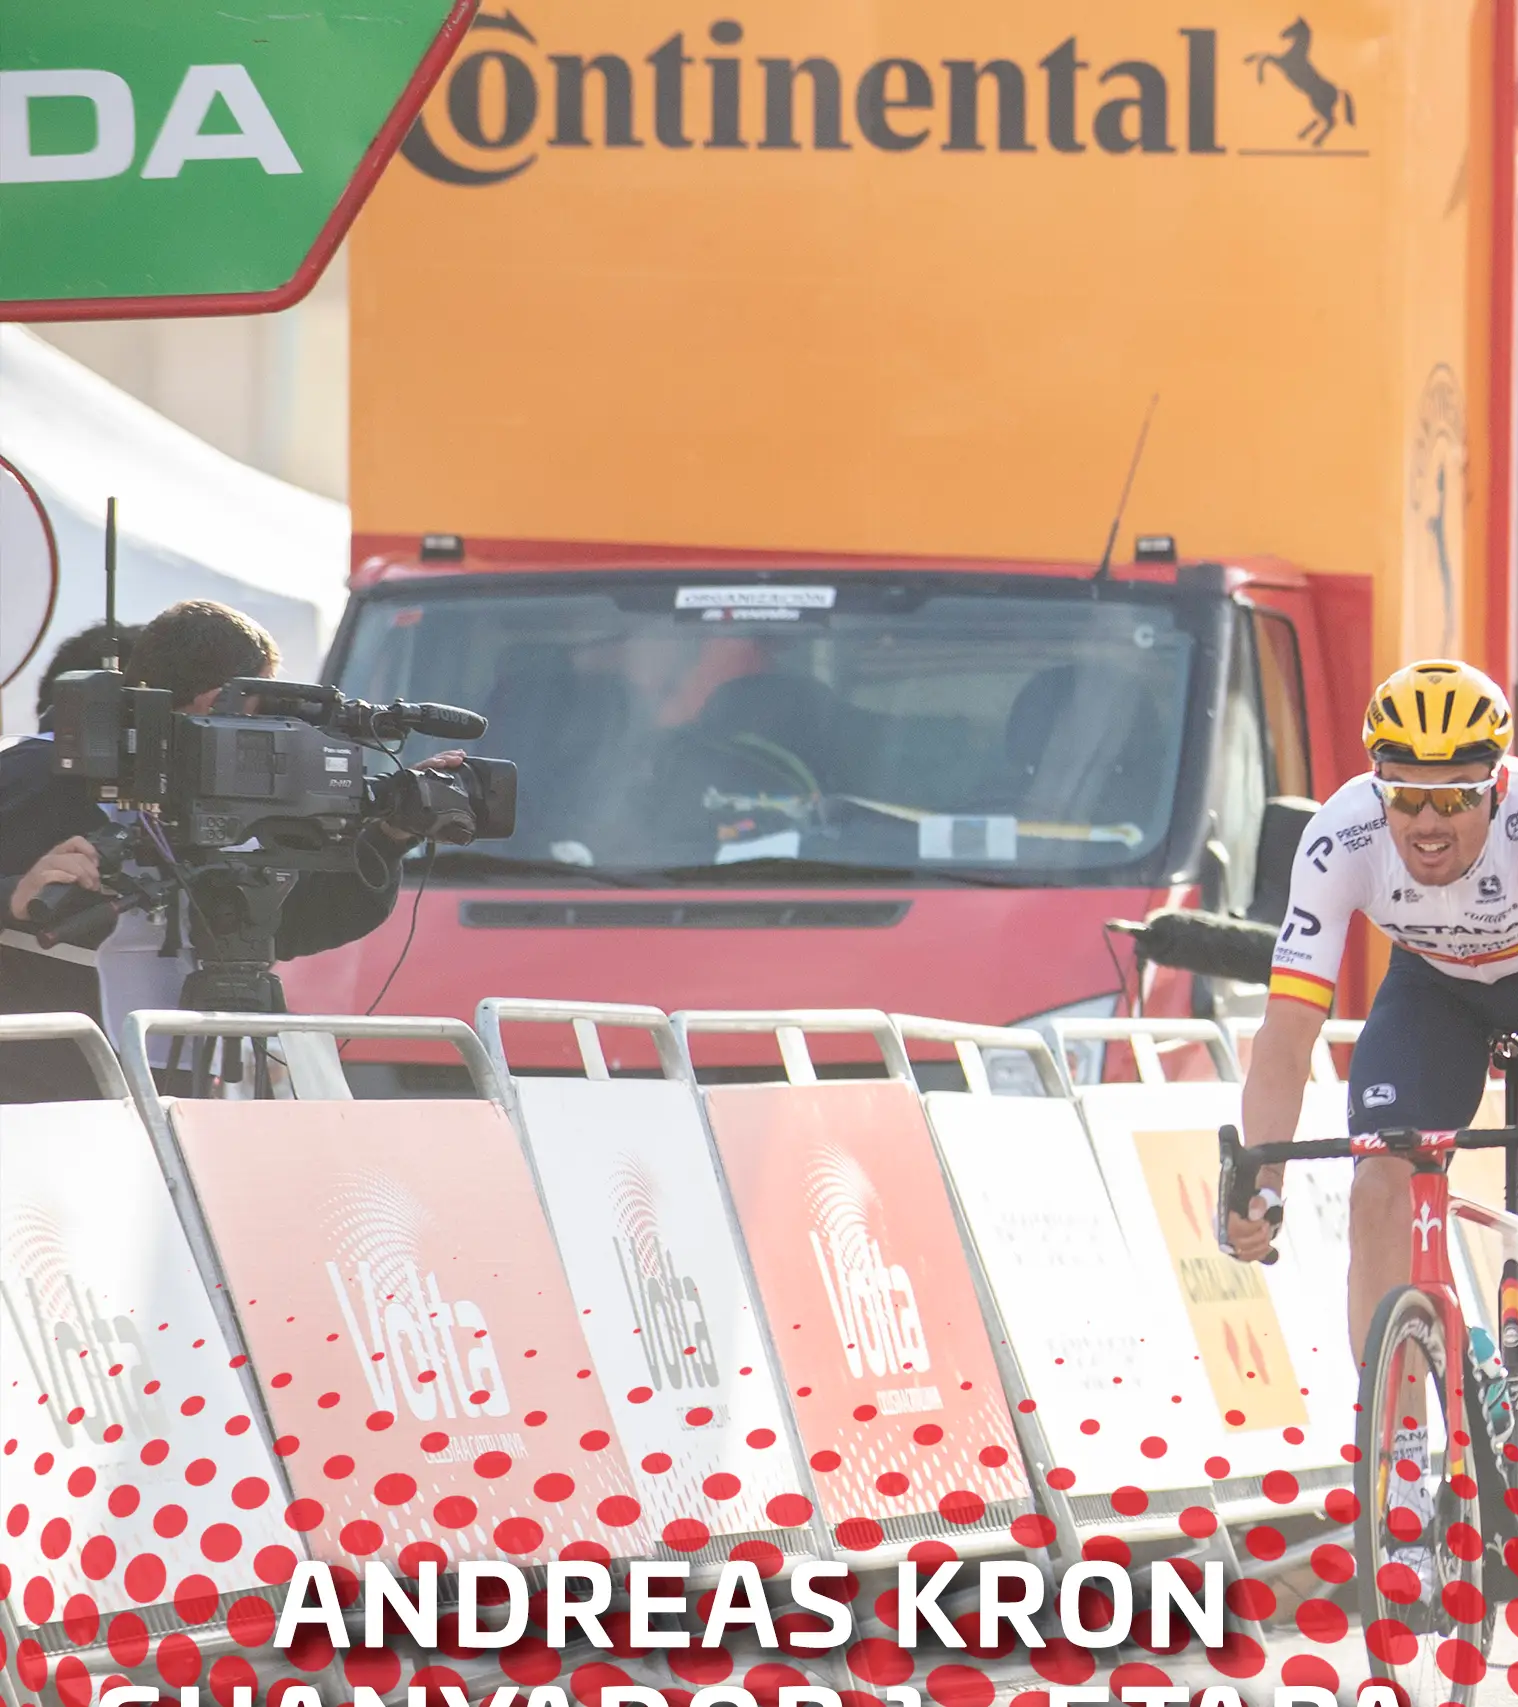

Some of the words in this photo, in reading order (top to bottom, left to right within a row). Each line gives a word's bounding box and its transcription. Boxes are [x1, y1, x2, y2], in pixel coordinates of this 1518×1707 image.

[0, 63, 304, 183] DA
[400, 6, 1227, 188] Continental
[1335, 817, 1388, 842] PREMIER
[1343, 834, 1373, 853] TECH
[325, 1260, 510, 1421] Volta
